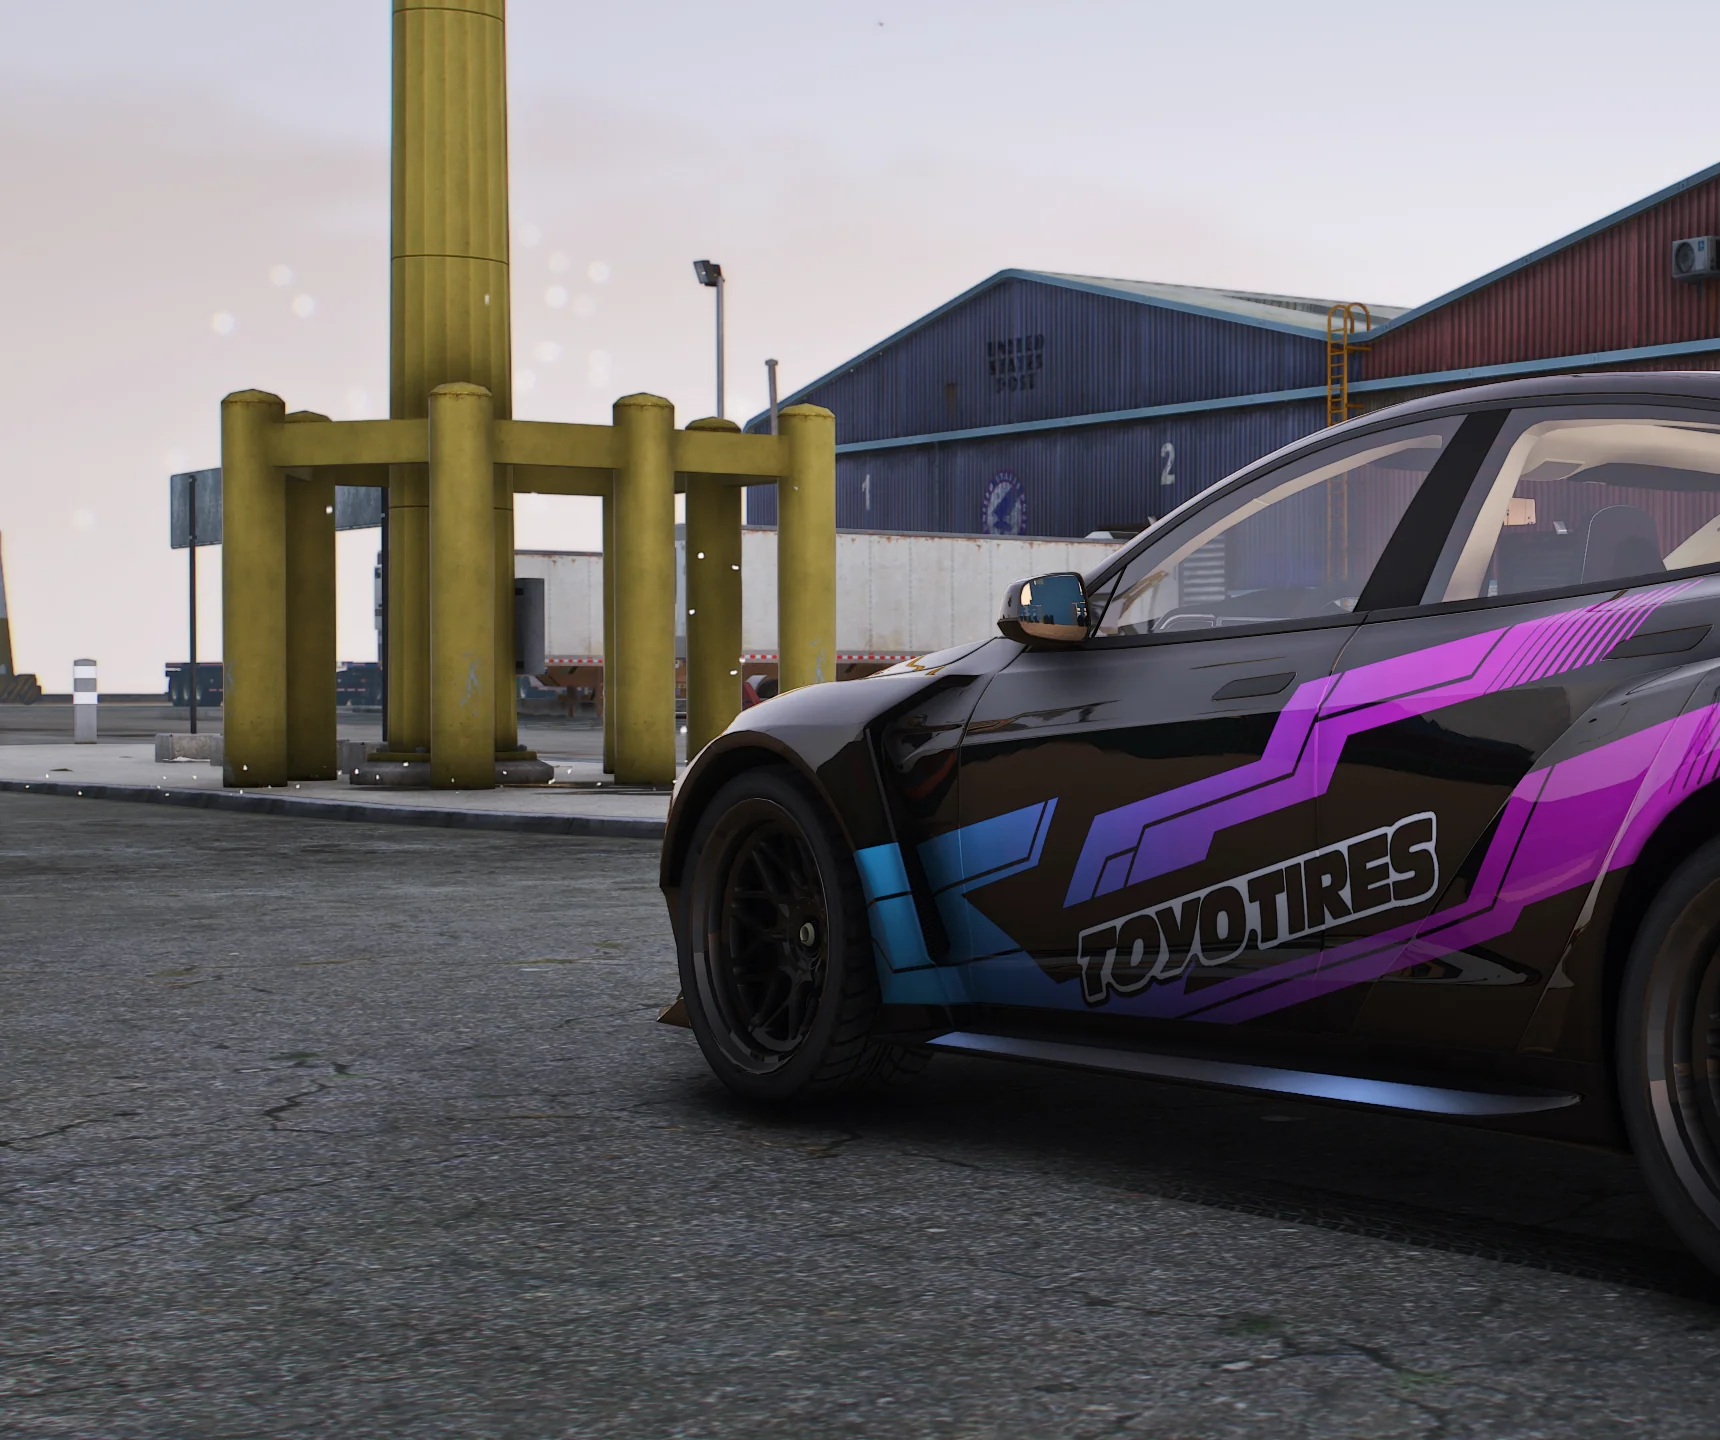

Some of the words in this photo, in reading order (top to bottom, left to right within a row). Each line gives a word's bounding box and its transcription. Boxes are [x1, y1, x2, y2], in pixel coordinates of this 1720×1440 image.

[1160, 442, 1175, 485] 2
[861, 474, 871, 511] 1
[1078, 882, 1248, 1003] TOYO
[1246, 811, 1439, 950] TIRES
